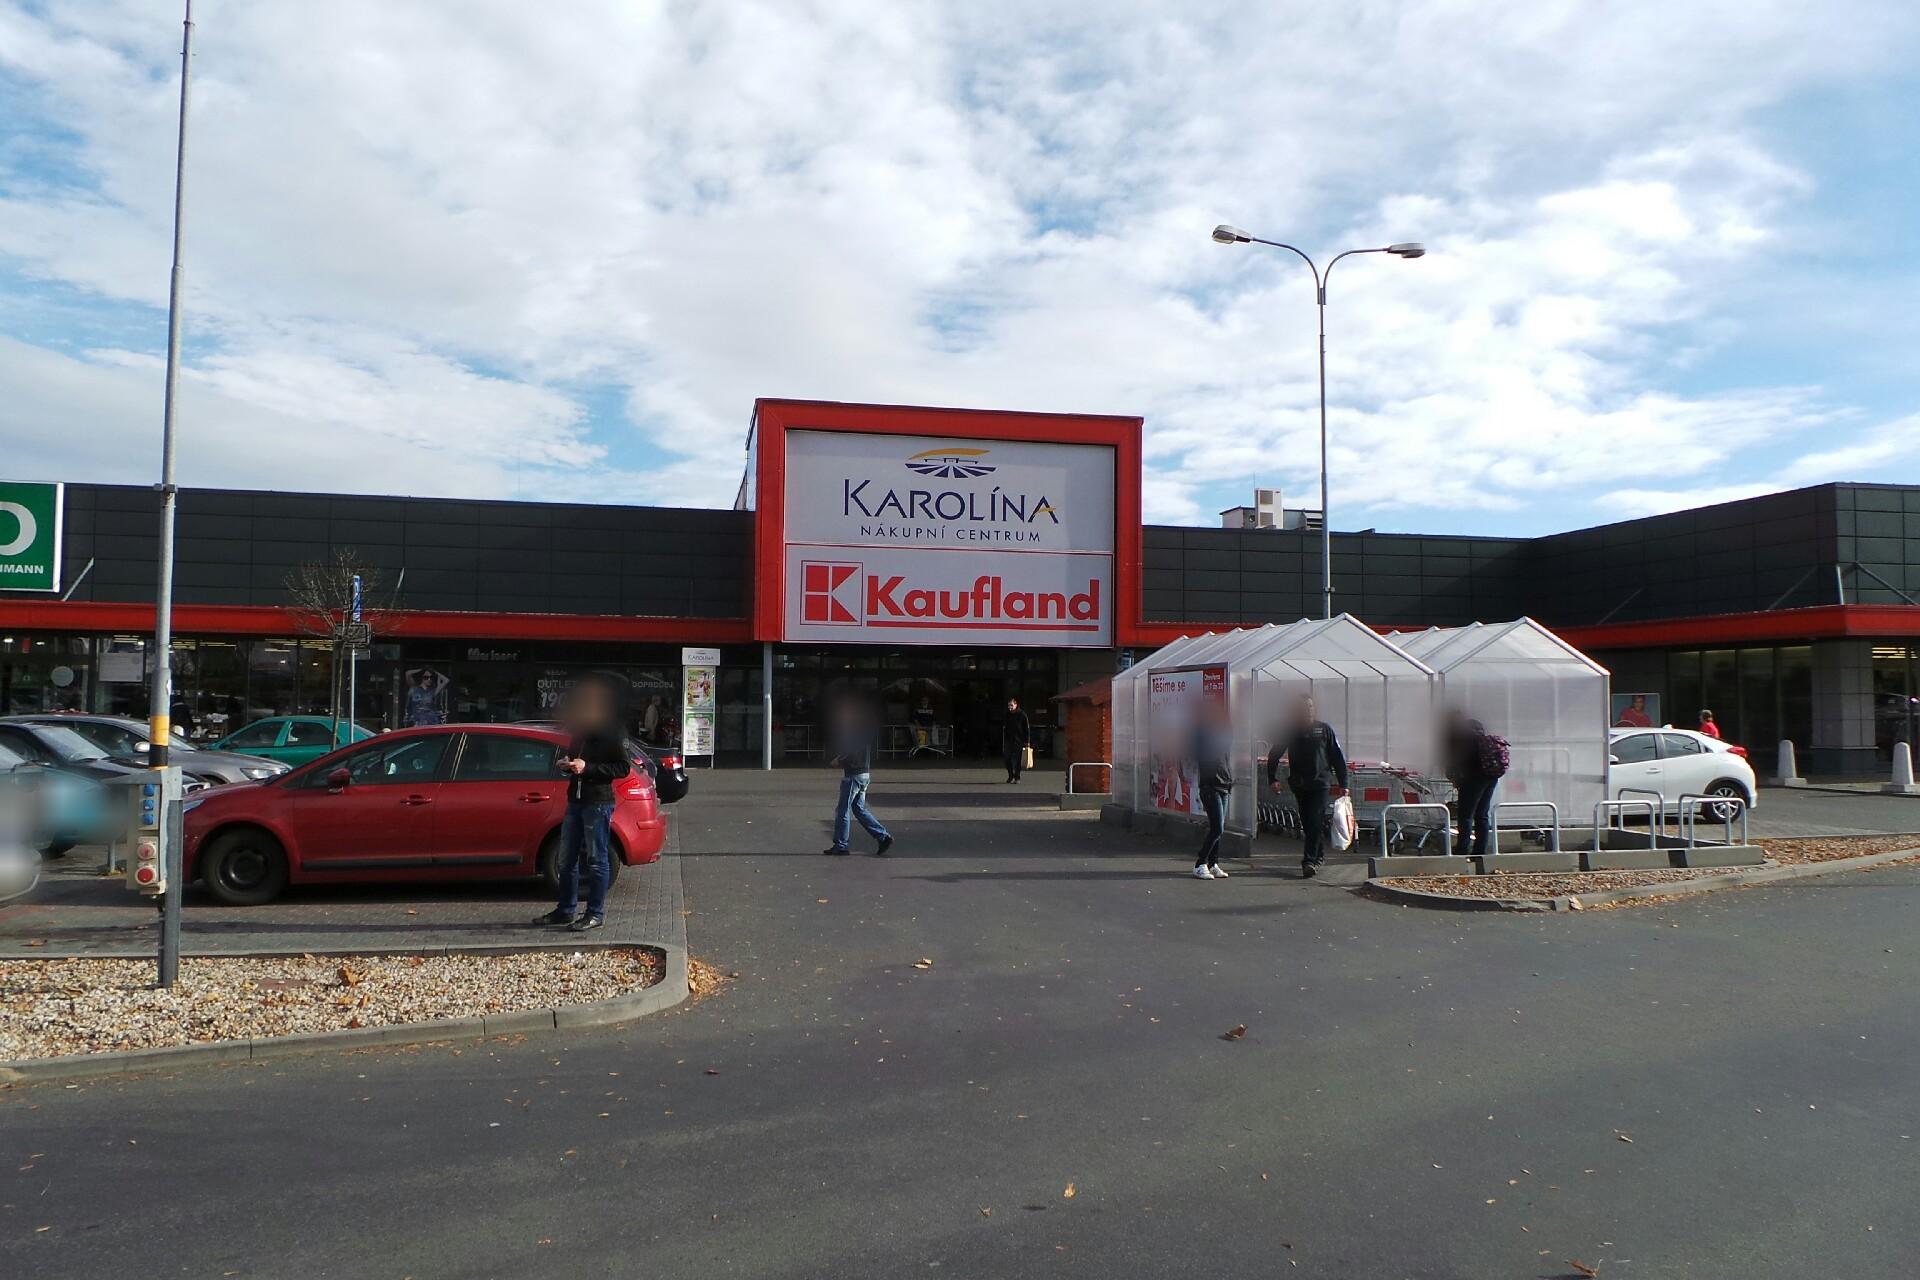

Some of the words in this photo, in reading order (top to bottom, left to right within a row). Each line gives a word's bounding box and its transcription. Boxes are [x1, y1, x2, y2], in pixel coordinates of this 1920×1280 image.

[844, 478, 1059, 524] KAROLÍNA
[860, 524, 946, 540] NÁKUPNÍ
[956, 528, 1041, 542] CENTRUM
[0, 564, 44, 574] MANN
[867, 576, 1099, 620] Kaufland
[1152, 677, 1175, 693] Těšíme
[1178, 680, 1186, 692] se
